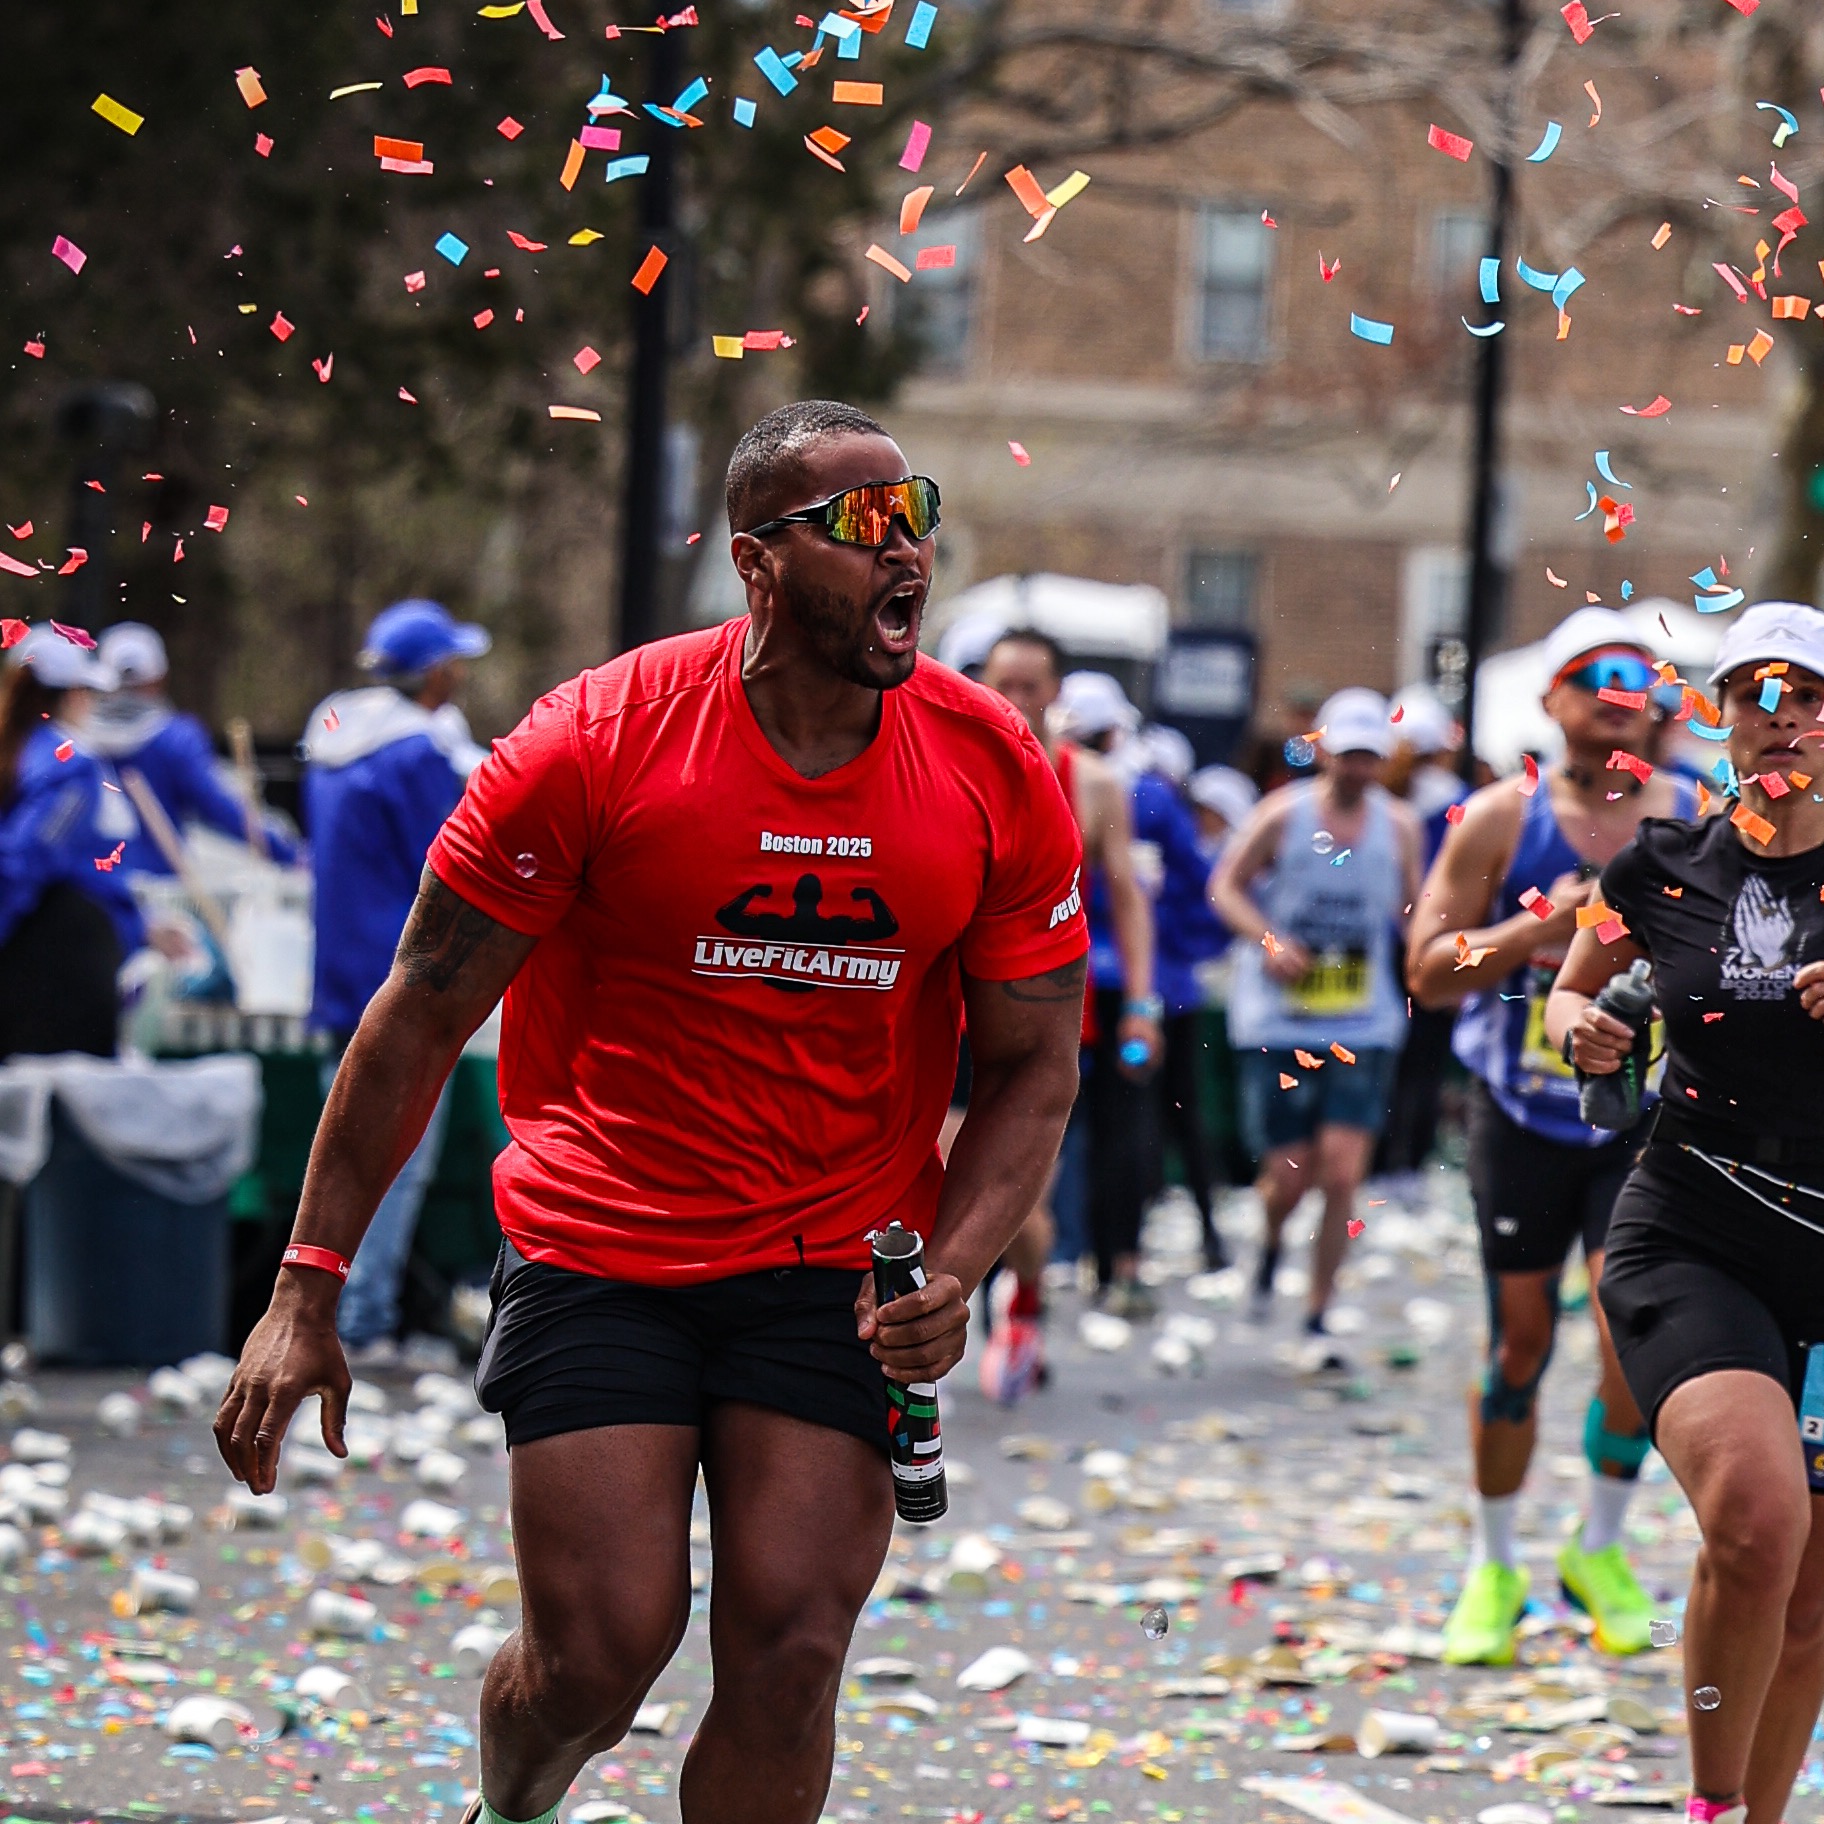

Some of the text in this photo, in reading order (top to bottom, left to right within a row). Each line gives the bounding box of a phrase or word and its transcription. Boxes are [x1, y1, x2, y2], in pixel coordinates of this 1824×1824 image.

[760, 831, 872, 858] Boston 2025
[694, 941, 901, 985] LiveFitArmy
